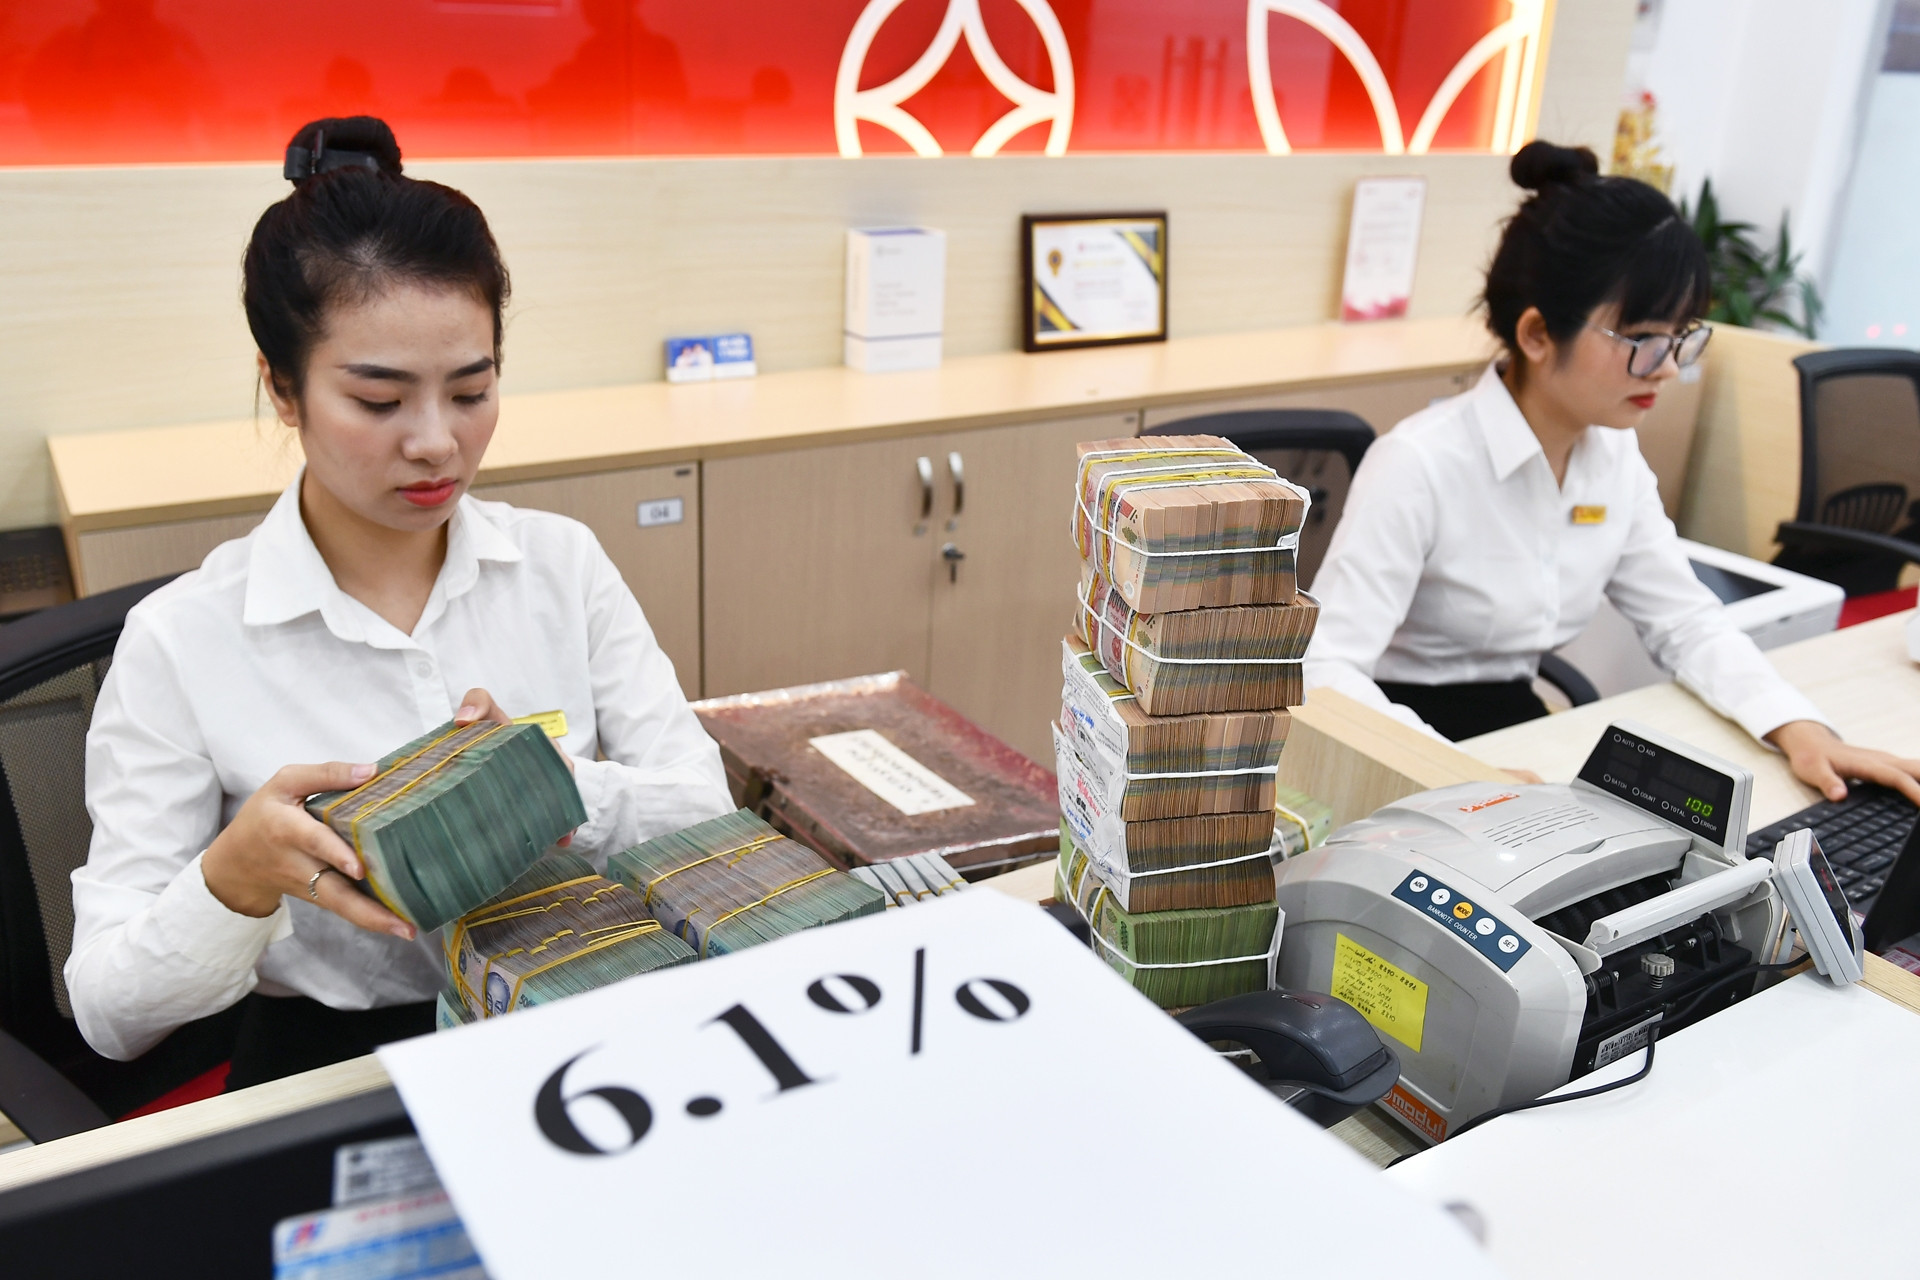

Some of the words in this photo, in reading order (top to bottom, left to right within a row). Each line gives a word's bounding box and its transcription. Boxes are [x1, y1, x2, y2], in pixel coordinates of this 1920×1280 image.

[1621, 738, 1635, 748] AUTO
[1645, 748, 1656, 757] ADD
[1611, 777, 1628, 790] BATCH
[1640, 791, 1656, 803] COUNT
[1670, 805, 1686, 817] TOTAL
[1700, 820, 1717, 832] ERROR
[1685, 797, 1713, 817] 100
[1413, 880, 1425, 889] ADD
[1456, 904, 1471, 917] MODE
[1426, 905, 1453, 924] BANKNOTE
[1453, 922, 1478, 941] COUNTER
[1502, 939, 1515, 950] SET
[534, 945, 1031, 1157] 6.1%
